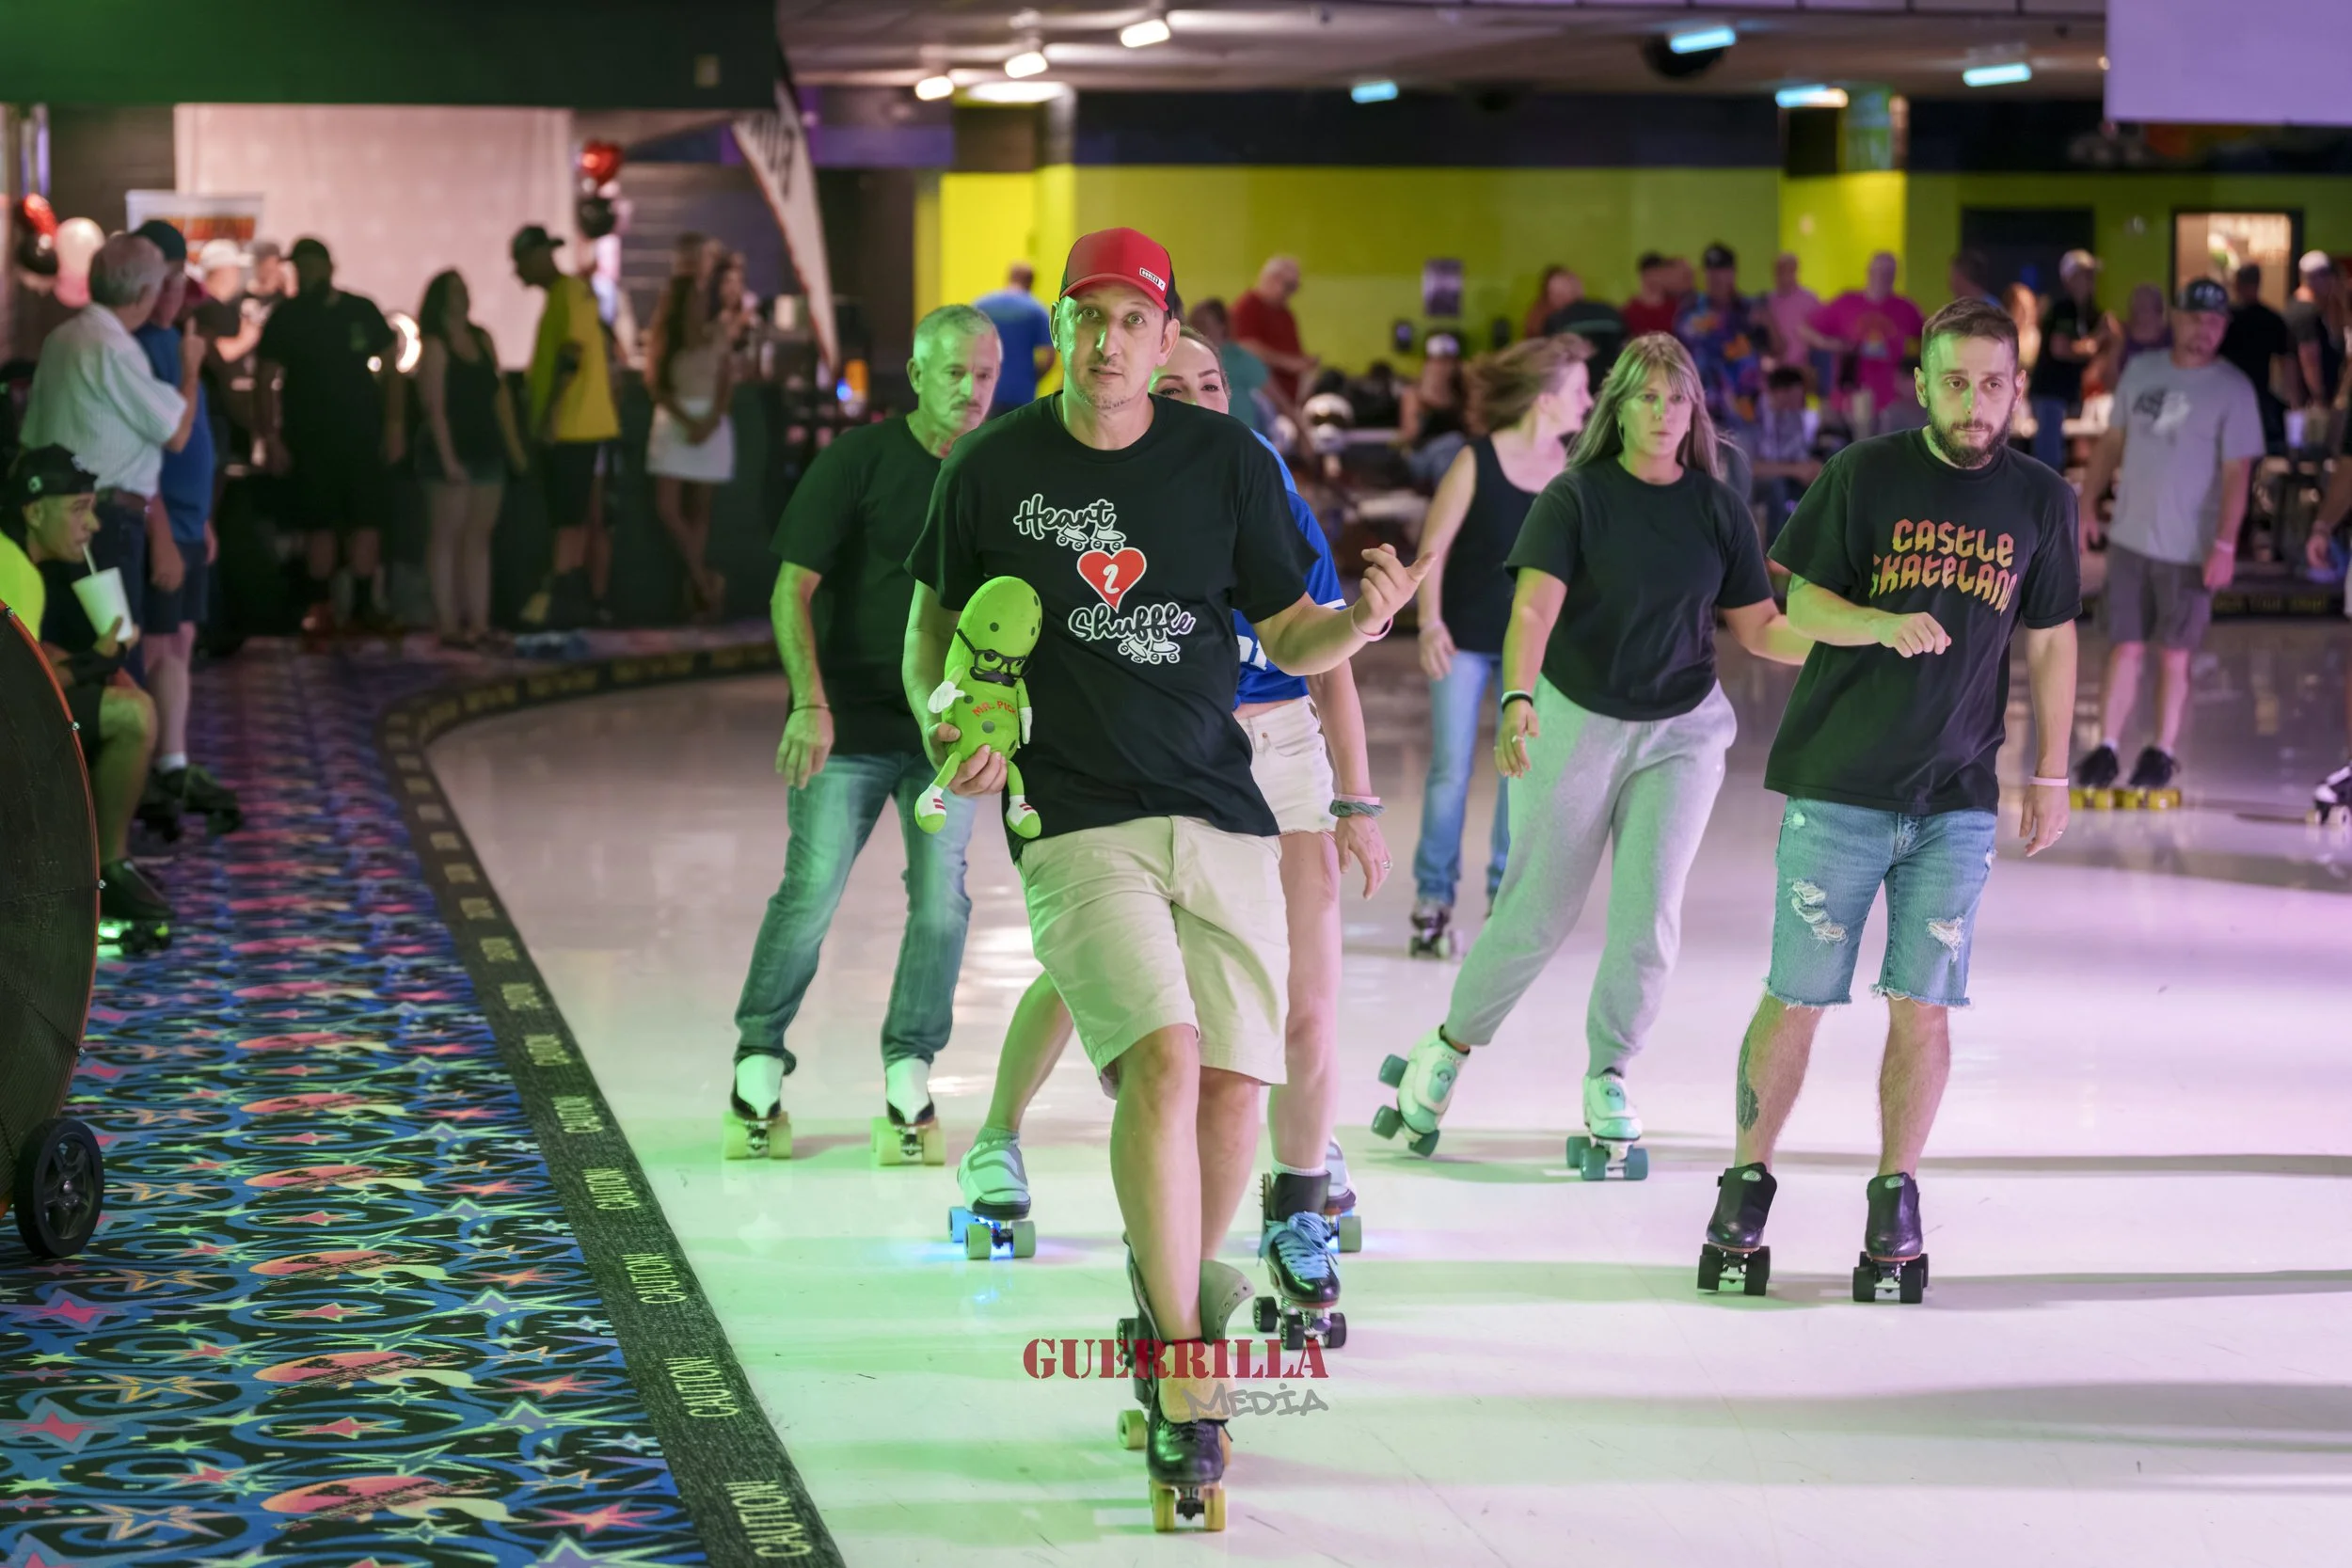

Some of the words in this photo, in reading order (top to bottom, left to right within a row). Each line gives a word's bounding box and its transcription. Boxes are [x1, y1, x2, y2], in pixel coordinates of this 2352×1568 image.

[1013, 493, 1117, 540] Heart
[1103, 563, 1120, 594] 2
[1068, 602, 1196, 642] Shuffle
